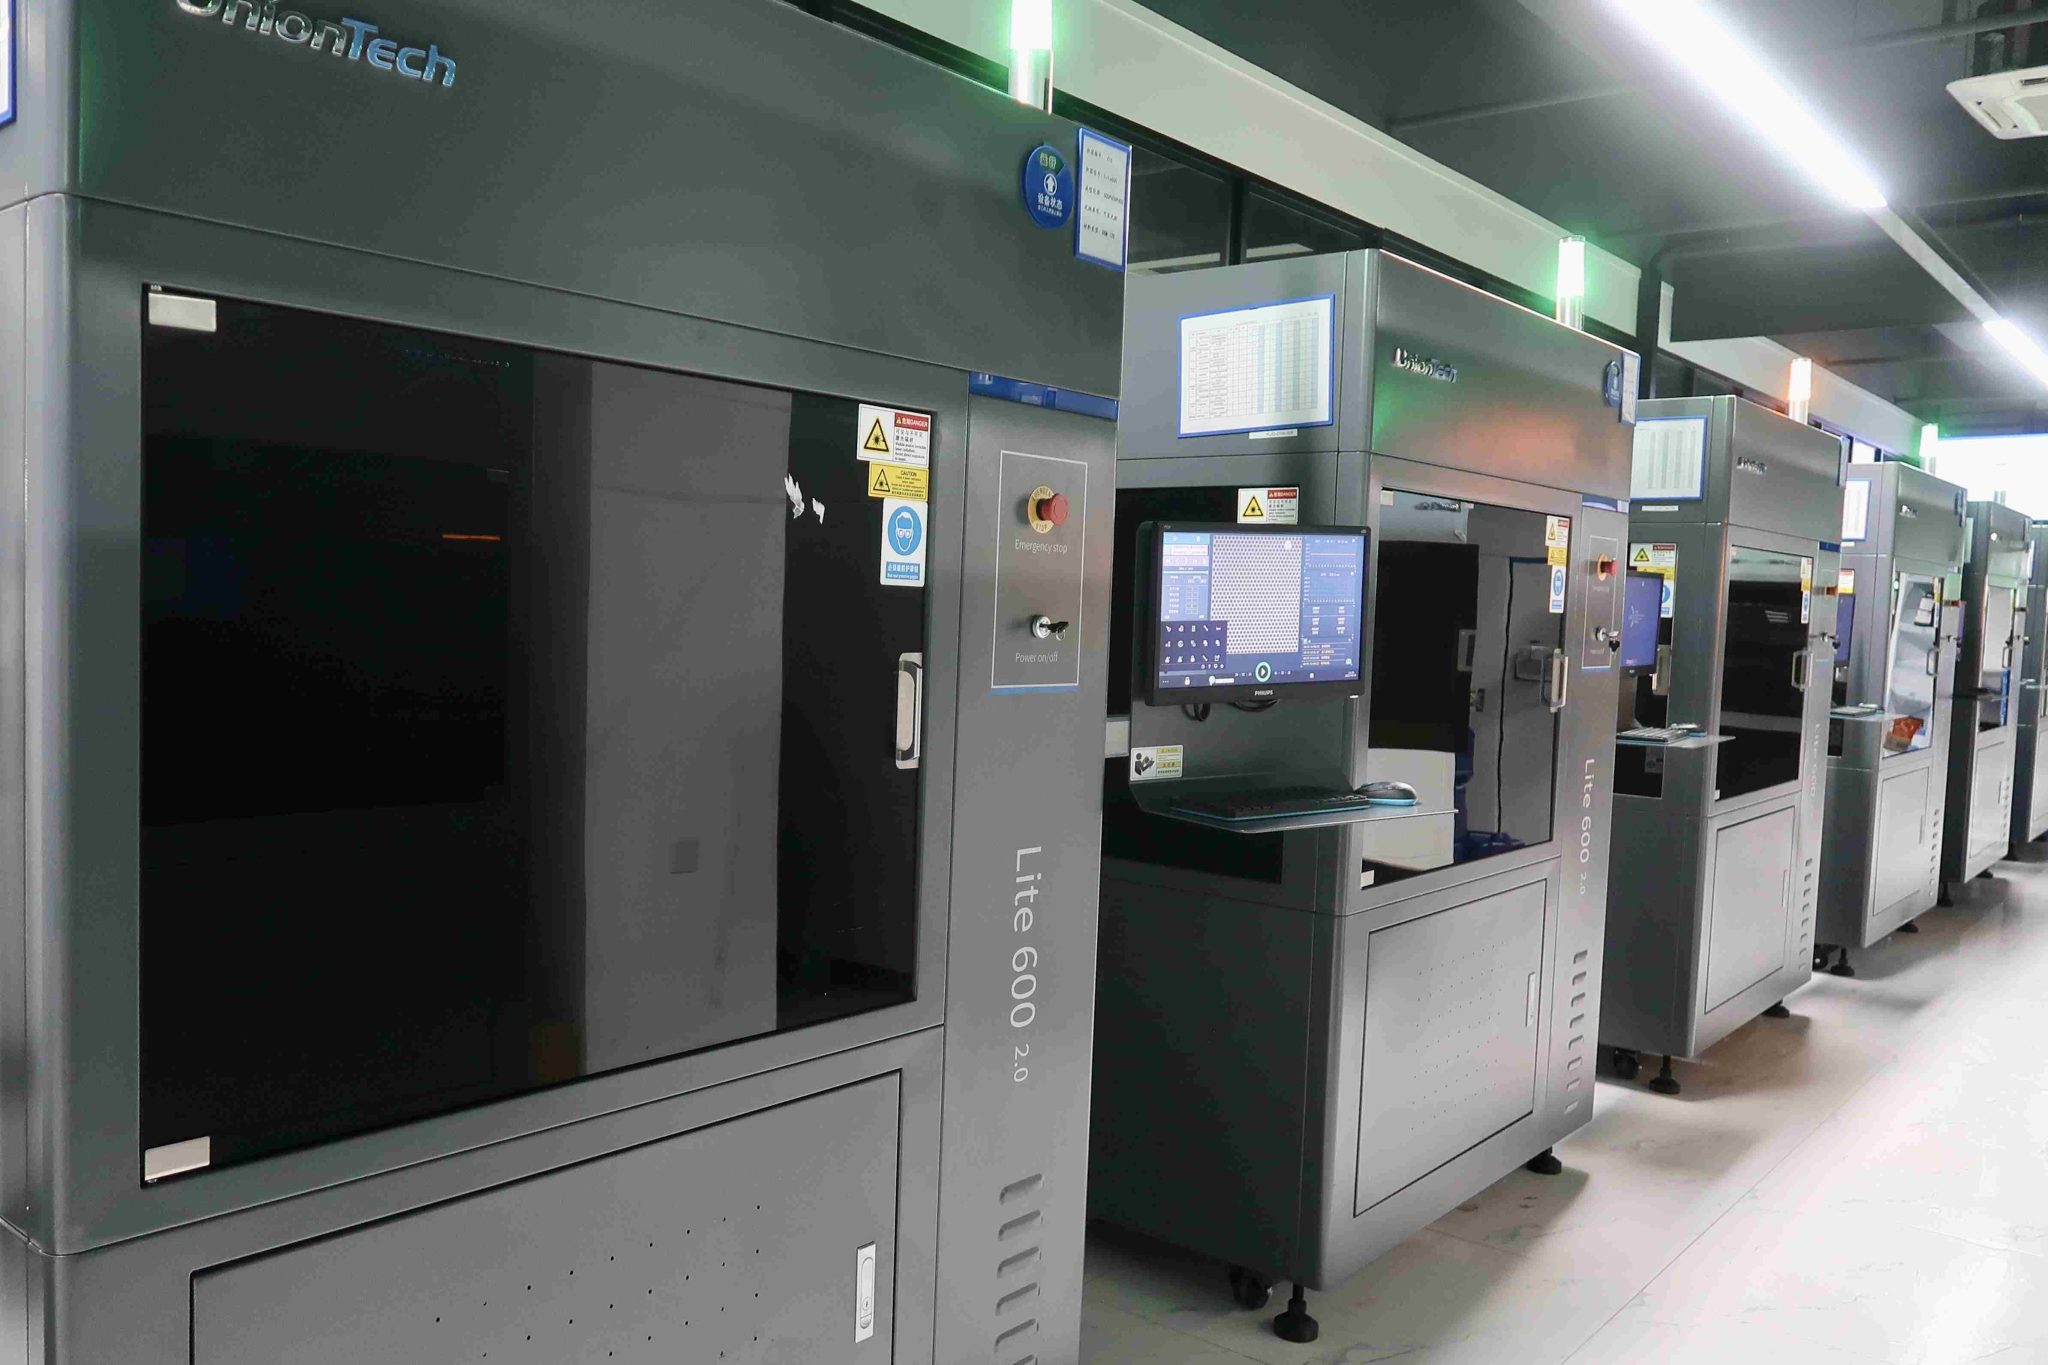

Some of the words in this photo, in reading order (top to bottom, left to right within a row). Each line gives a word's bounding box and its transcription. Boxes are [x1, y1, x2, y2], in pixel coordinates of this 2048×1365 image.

[1015, 539, 1052, 555] Emergency
[1052, 543, 1068, 556] stop
[1015, 652, 1037, 663] Power
[1583, 758, 1595, 808] Lite
[1580, 816, 1592, 863] 600
[1014, 846, 1042, 932] Lite
[1010, 946, 1038, 1028] 600
[1014, 1043, 1030, 1083] 2.0
